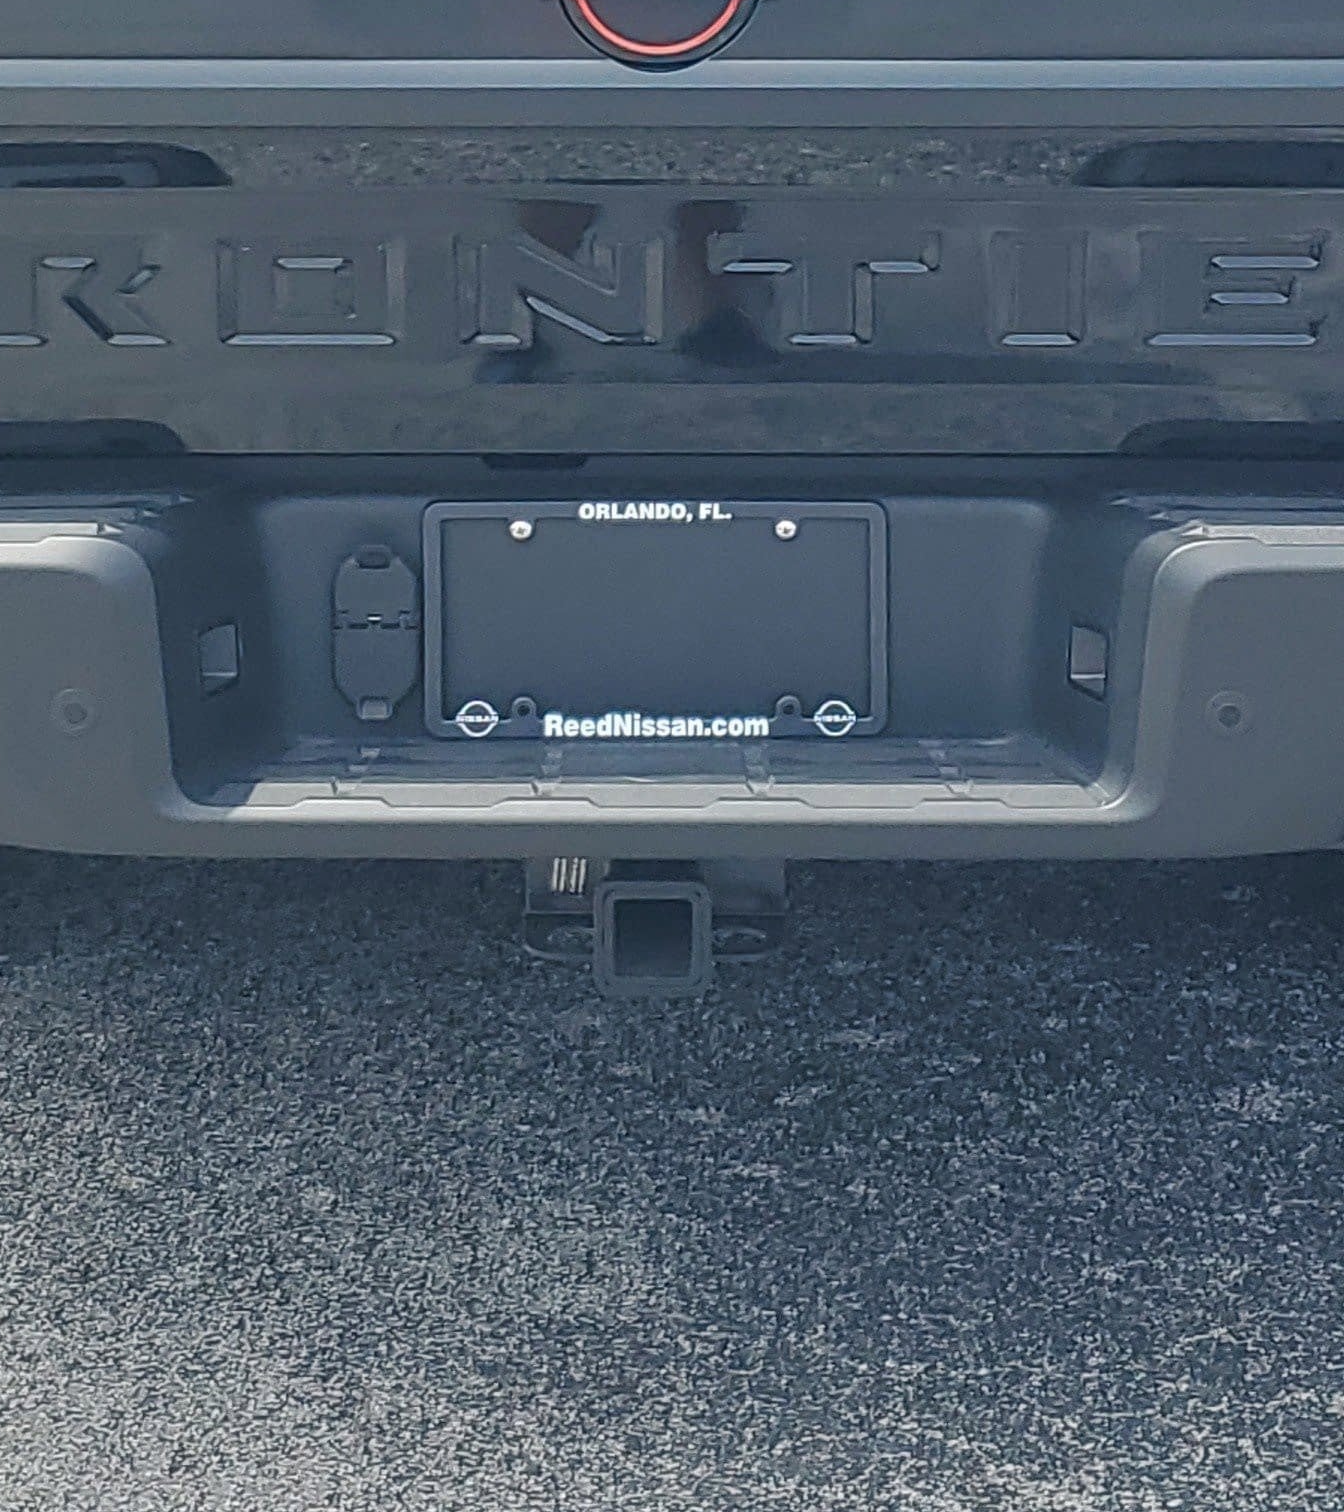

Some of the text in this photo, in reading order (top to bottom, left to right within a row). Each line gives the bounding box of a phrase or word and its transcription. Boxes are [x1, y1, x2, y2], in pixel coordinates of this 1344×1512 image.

[578, 502, 733, 523] ORLANDO, FL.
[543, 713, 770, 738] ReedNissan.com
